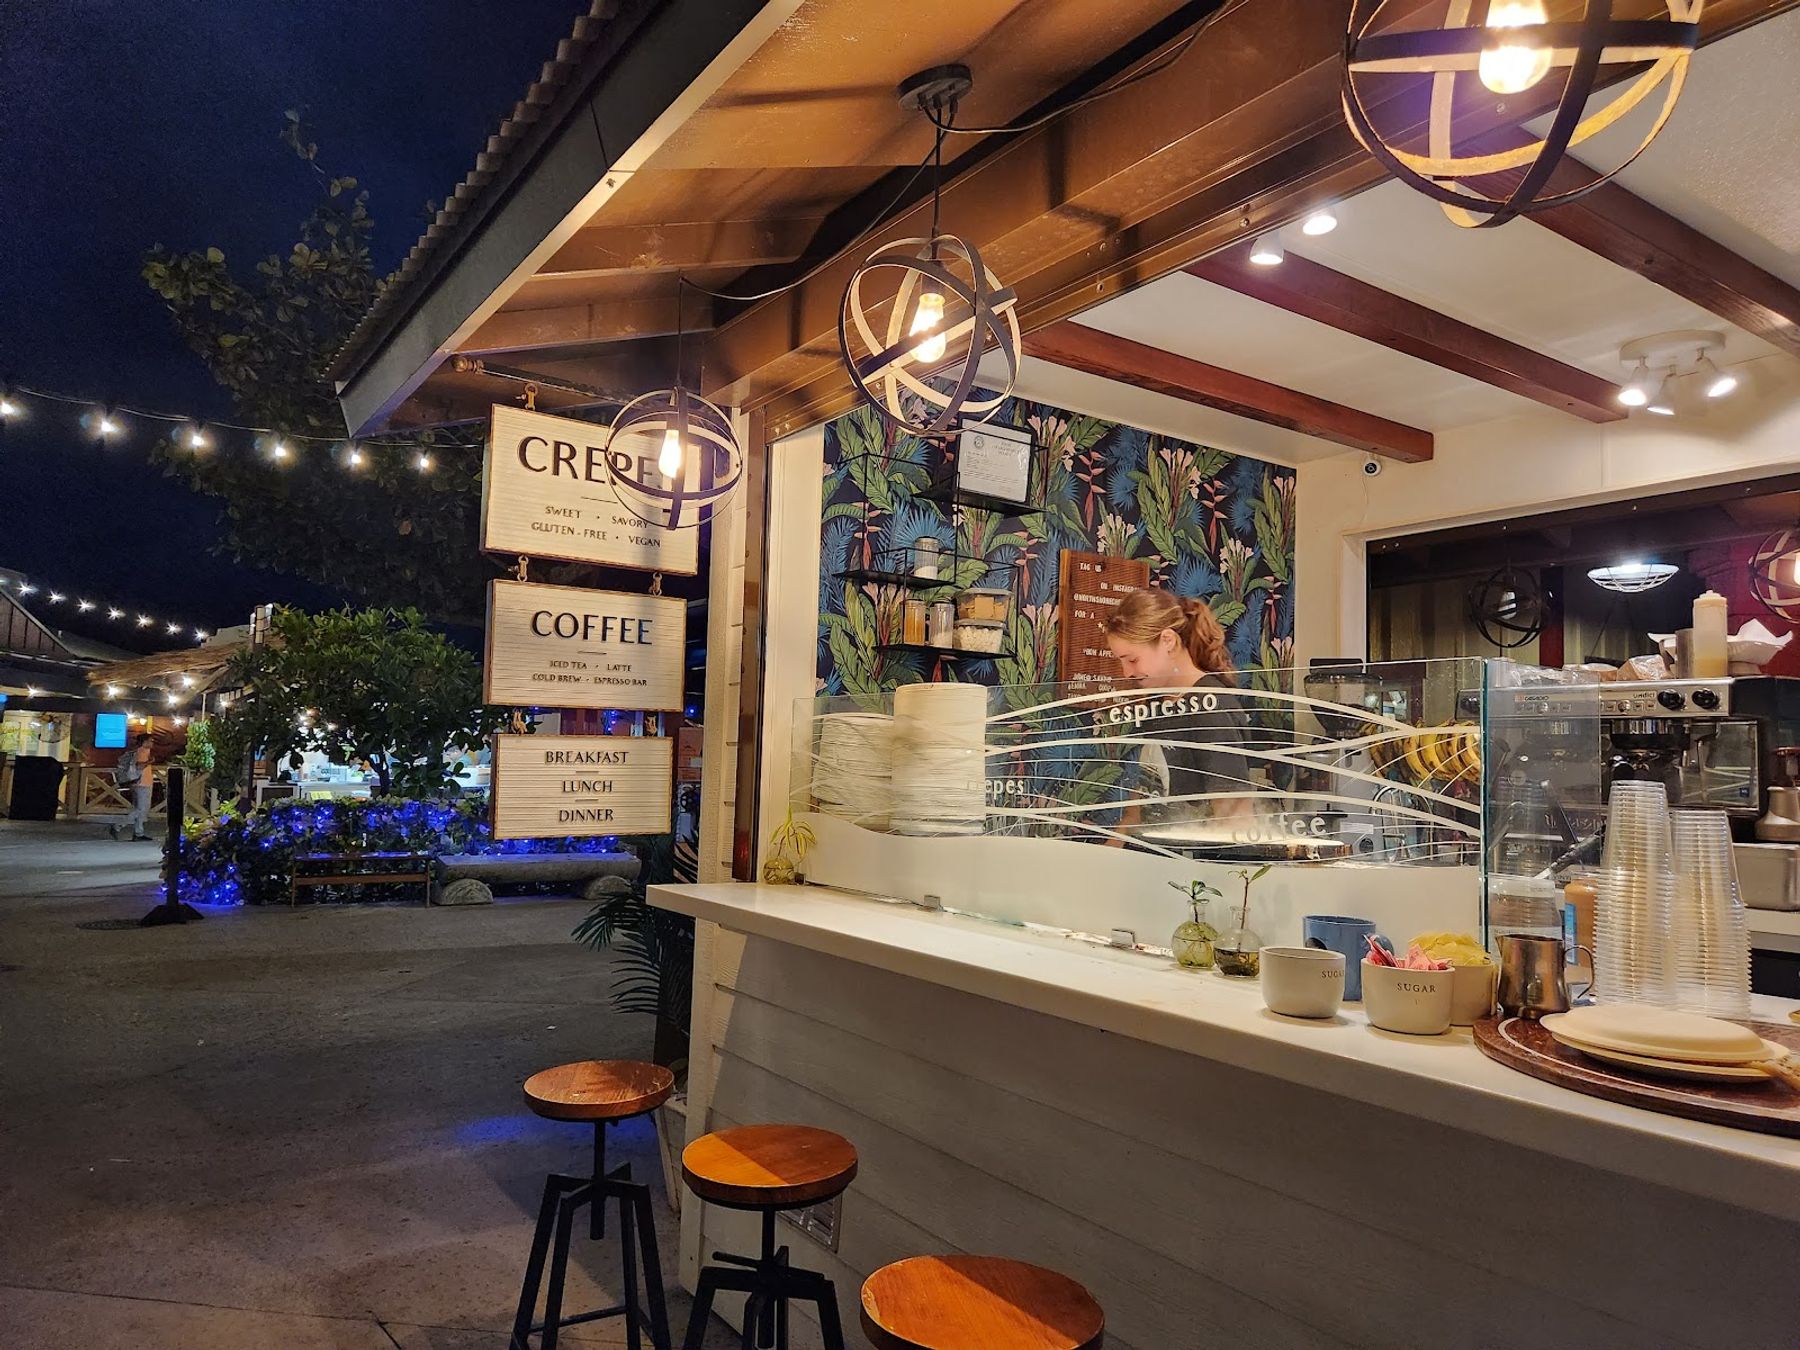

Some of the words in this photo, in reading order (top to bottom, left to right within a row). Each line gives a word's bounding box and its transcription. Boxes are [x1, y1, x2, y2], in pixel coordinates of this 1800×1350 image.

[517, 436, 664, 488] CREPE
[545, 506, 581, 519] SWEET
[611, 516, 648, 529] SAVORY
[628, 535, 661, 548] VEGAN
[1074, 610, 1087, 619] FOR
[1090, 612, 1095, 620] A
[532, 610, 653, 645] COFFEE
[550, 660, 569, 669] ICED
[571, 661, 587, 670] TEA
[607, 663, 632, 672] LATTE
[532, 673, 556, 682] COLD
[558, 674, 582, 684] BREW
[594, 676, 631, 686] ESPRESSO
[632, 678, 647, 687] BAR
[1109, 693, 1217, 728] espresso
[545, 751, 629, 764] BREAKFAST
[562, 780, 613, 793] LUNCH
[559, 808, 614, 822] DINNER
[1397, 982, 1436, 993] SUGAR
